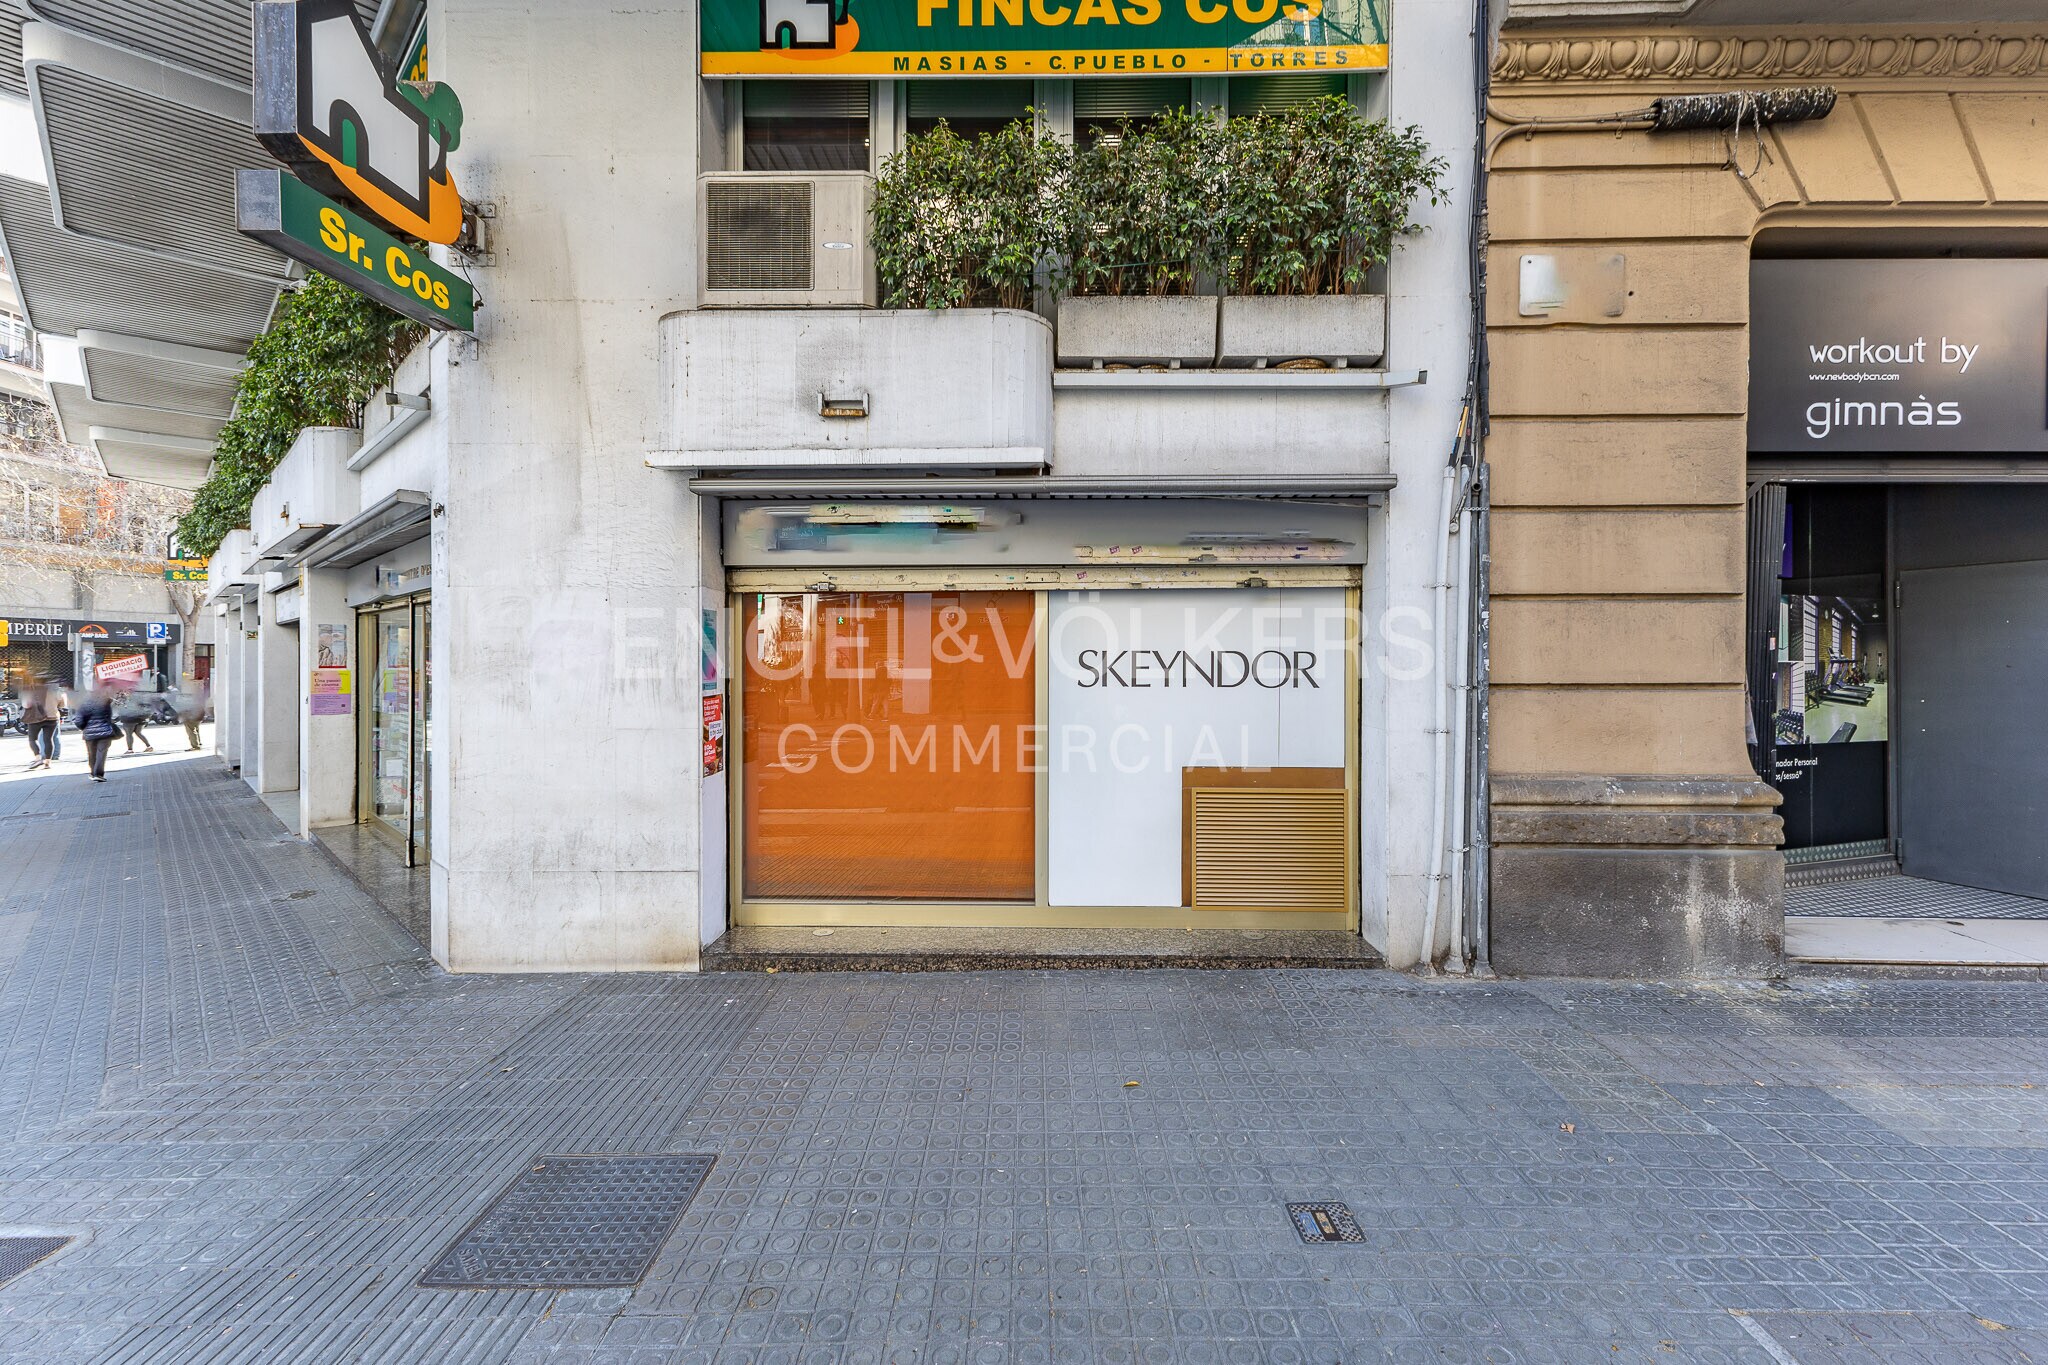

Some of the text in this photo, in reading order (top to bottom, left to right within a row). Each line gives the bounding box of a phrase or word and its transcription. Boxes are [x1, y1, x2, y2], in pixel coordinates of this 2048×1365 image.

[893, 55, 1008, 71] MASIAS
[1229, 50, 1349, 68] TORRES
[319, 207, 450, 310] Sr. Cos
[1808, 336, 1980, 374] workout by
[1808, 373, 1900, 384] www.newbodybcn.com
[1805, 394, 1962, 439] gimnàs
[172, 570, 187, 580] Sr.
[149, 623, 163, 637] P
[1077, 649, 1320, 689] SKEYNDOR
[1794, 757, 1818, 767] Personal
